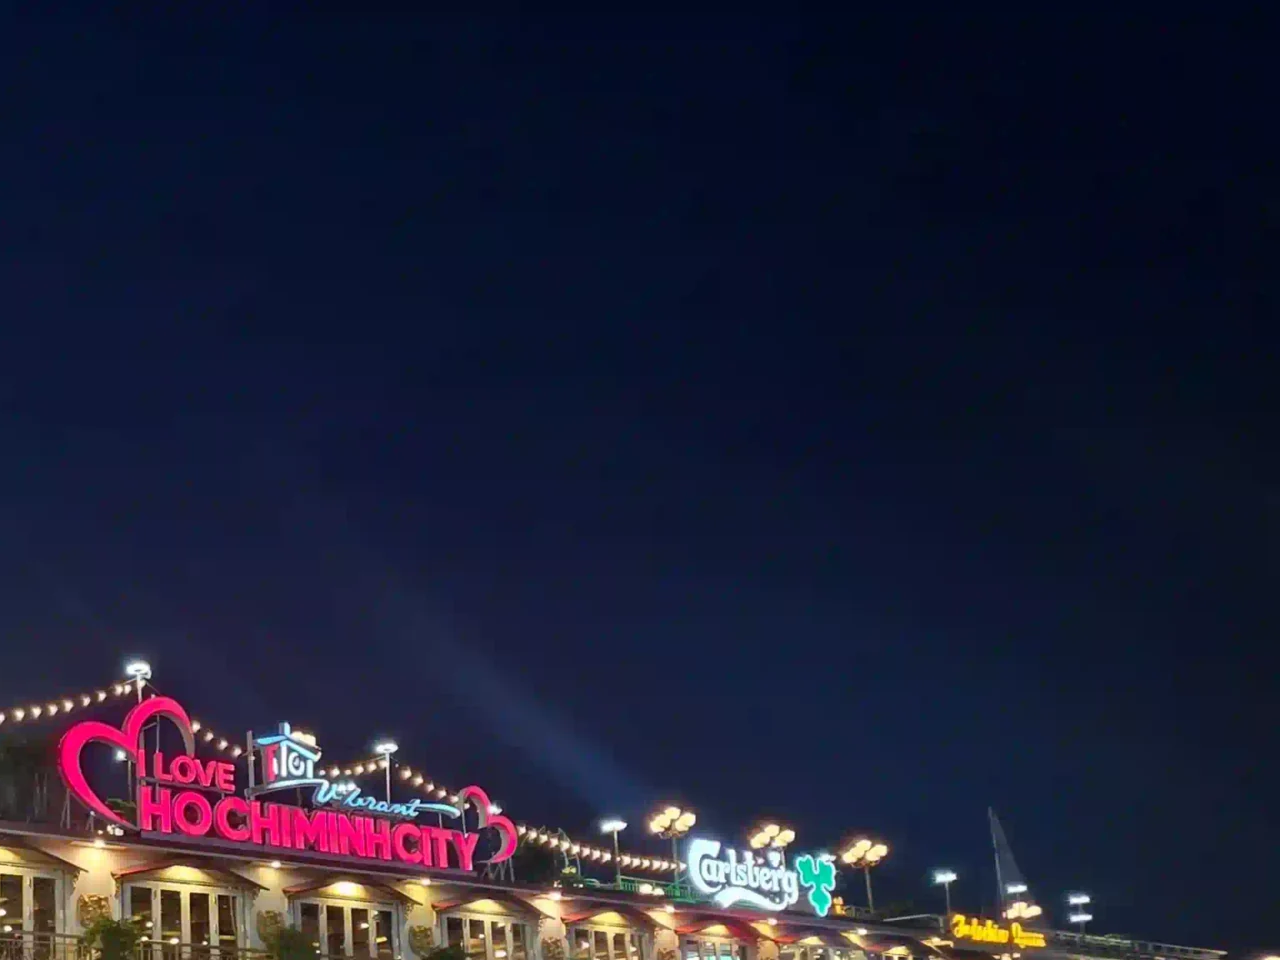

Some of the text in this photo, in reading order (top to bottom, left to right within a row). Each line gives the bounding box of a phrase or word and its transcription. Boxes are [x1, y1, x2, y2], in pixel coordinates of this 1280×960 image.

[138, 749, 235, 792] I LOVE
[688, 838, 799, 910] Carlsberg
